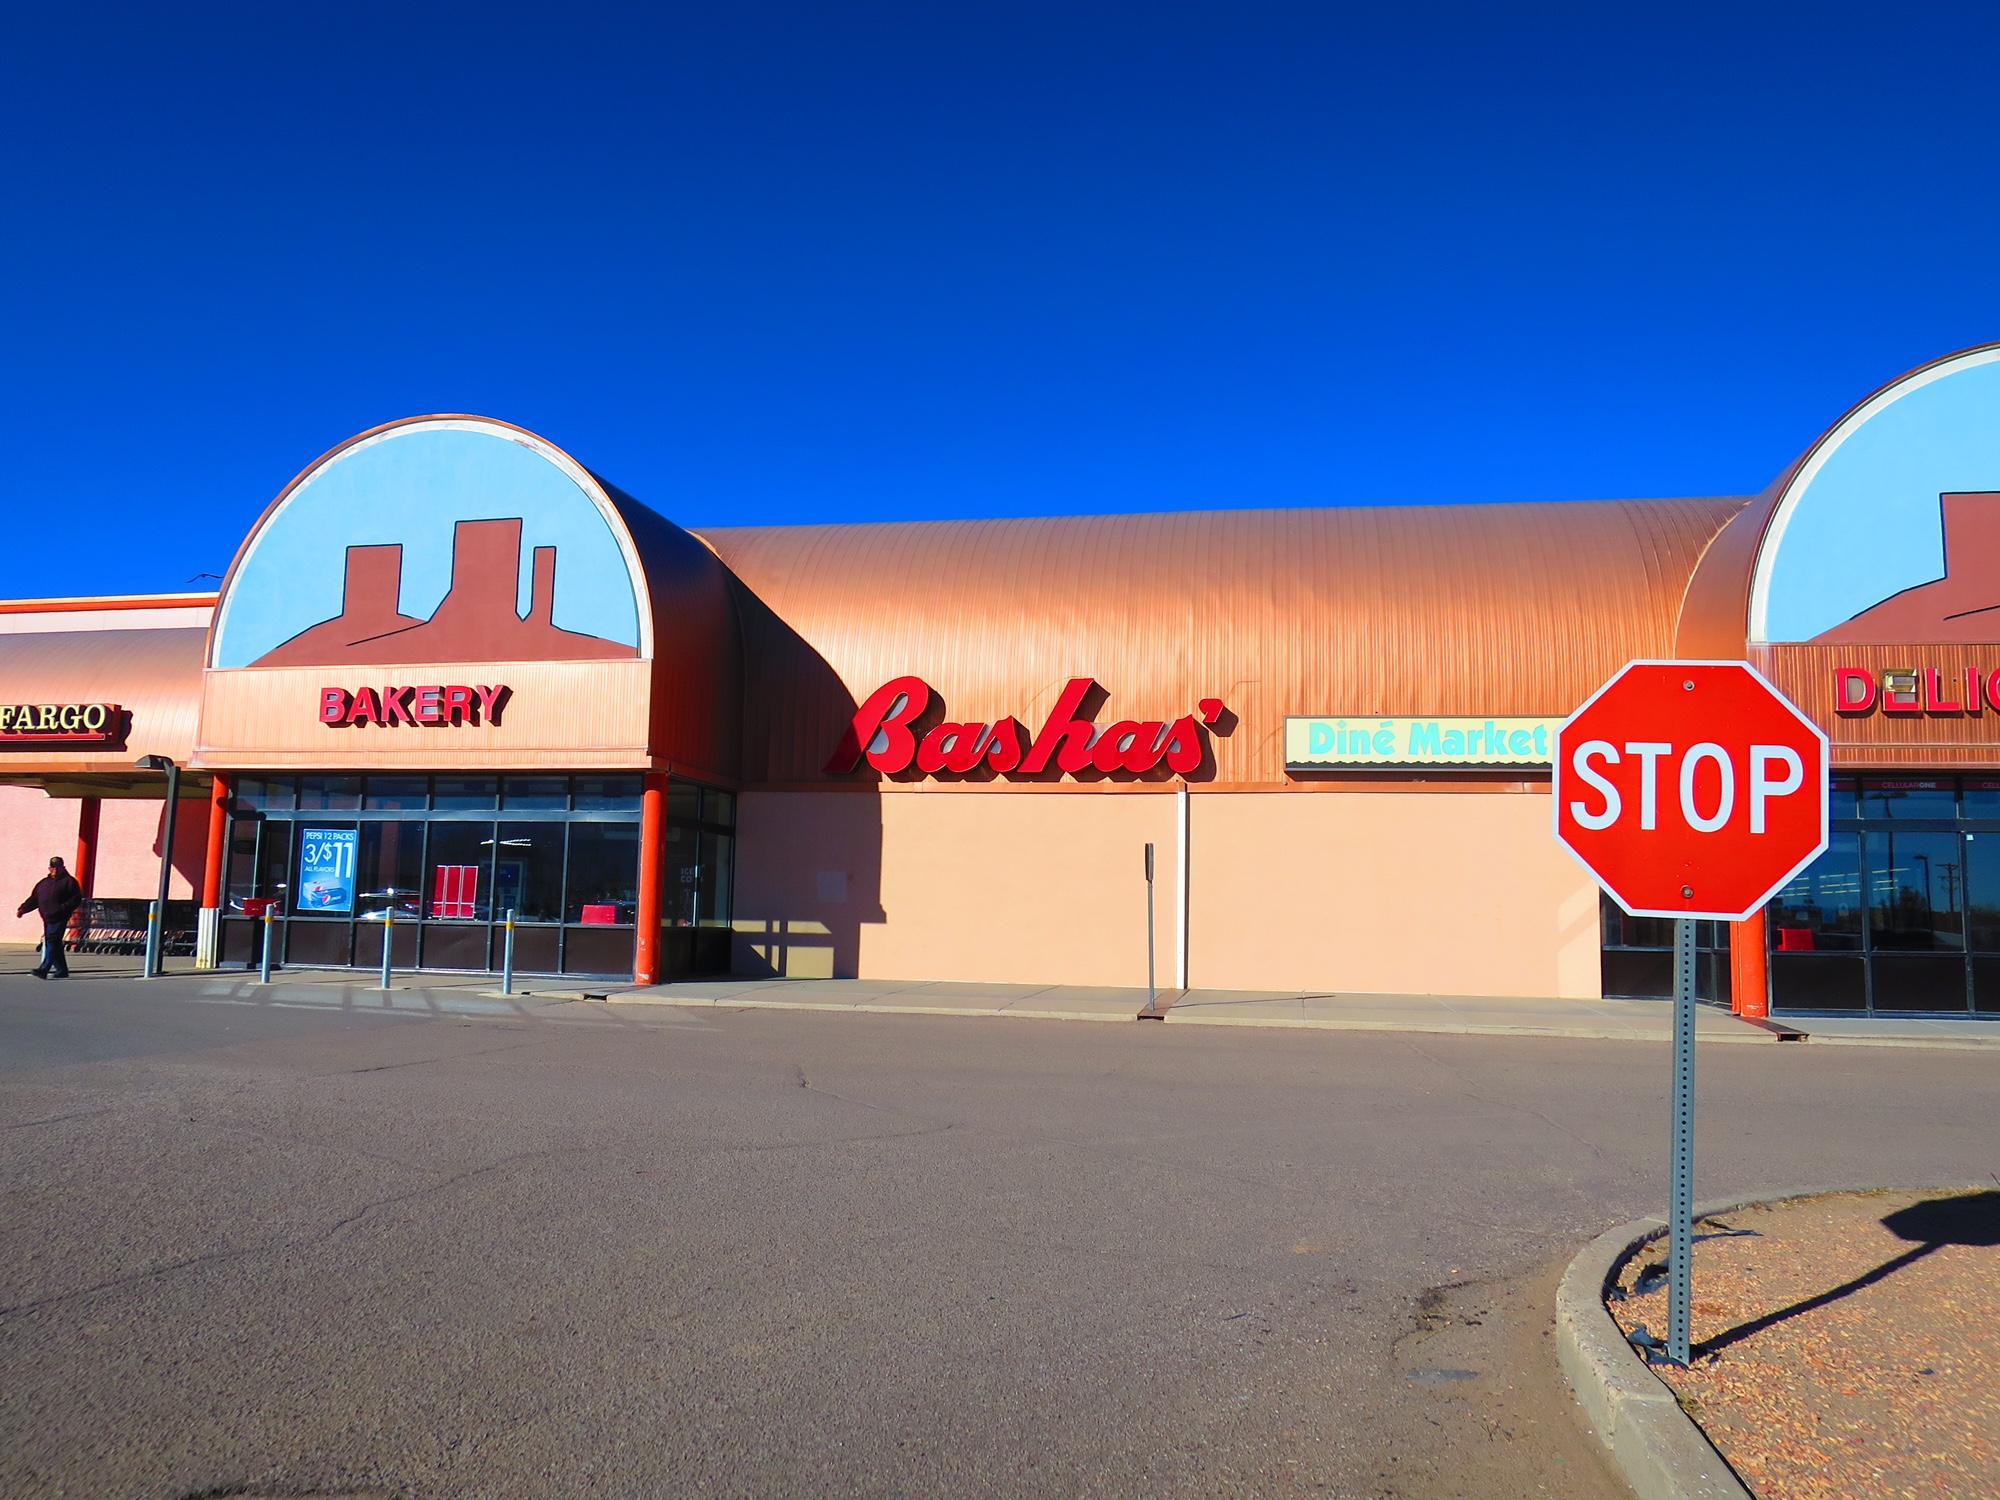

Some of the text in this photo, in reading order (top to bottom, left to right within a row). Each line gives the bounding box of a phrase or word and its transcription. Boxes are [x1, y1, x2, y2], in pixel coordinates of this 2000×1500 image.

[0, 703, 106, 730] FARGO
[319, 684, 506, 724] BAKERY
[822, 675, 1226, 774] Bashas'
[1308, 720, 1548, 756] Diné Market
[1570, 740, 1804, 834] STOP
[306, 832, 354, 840] PEPSI 12 PACKS
